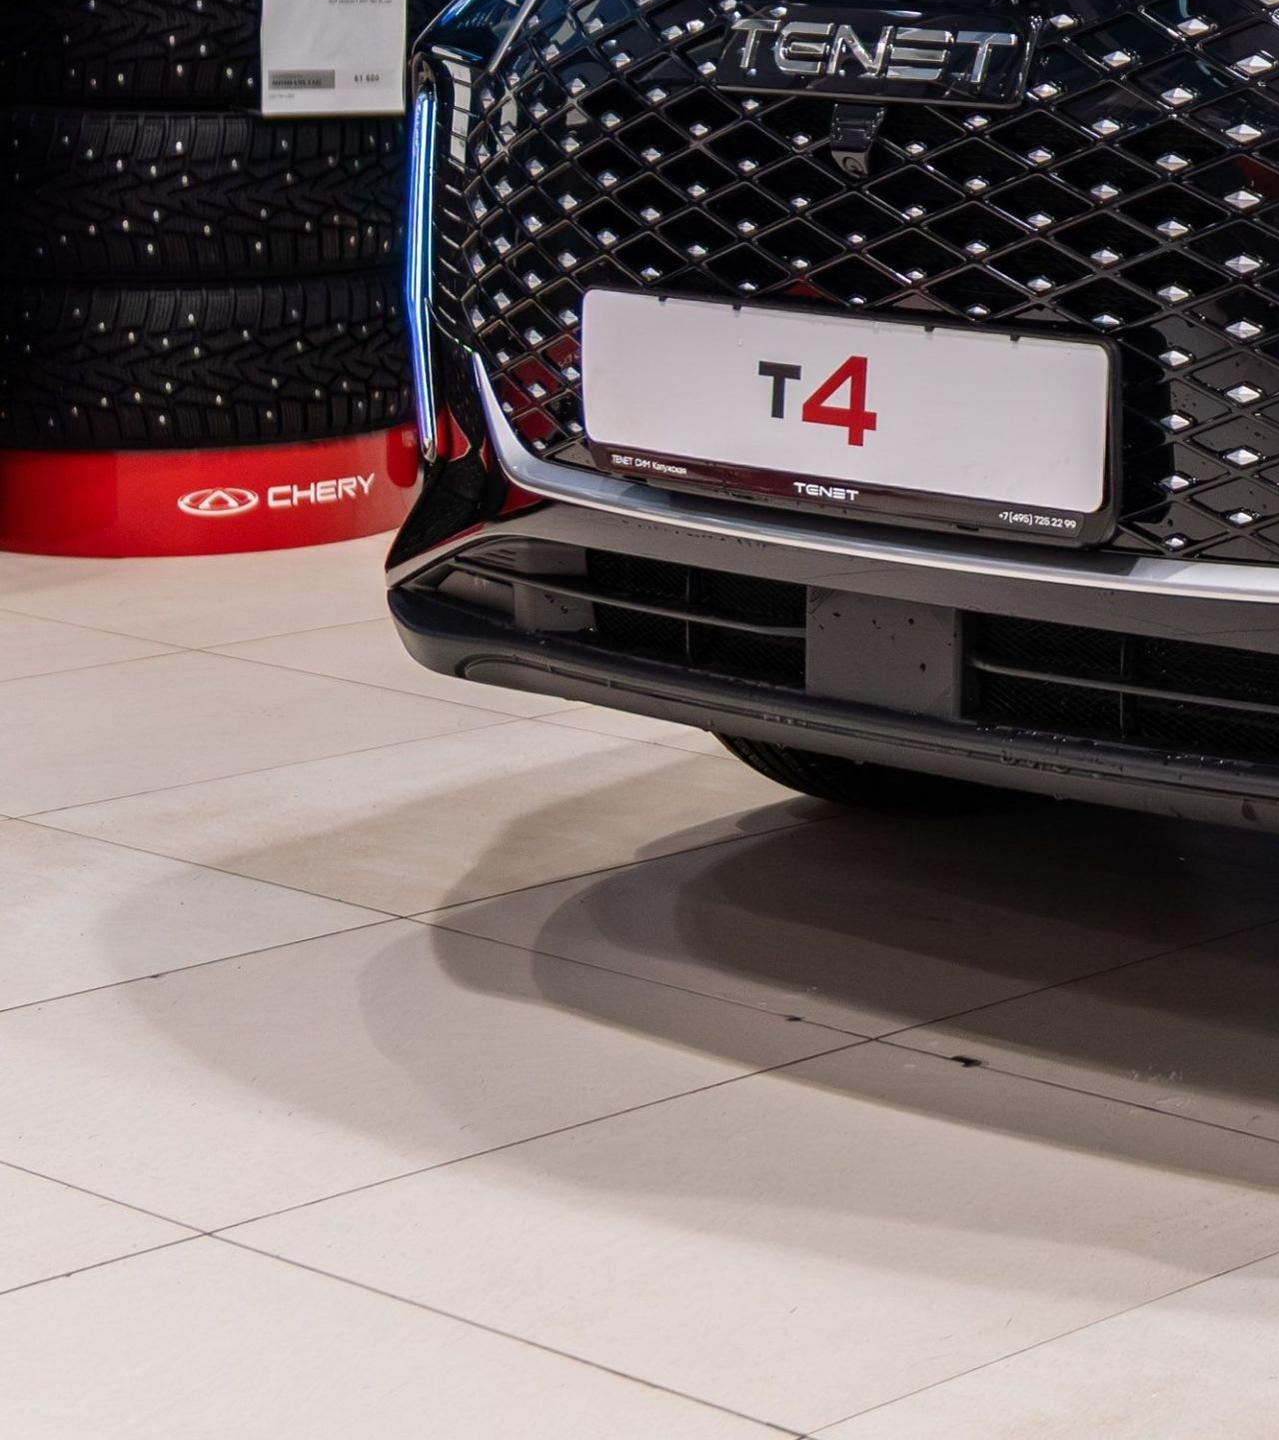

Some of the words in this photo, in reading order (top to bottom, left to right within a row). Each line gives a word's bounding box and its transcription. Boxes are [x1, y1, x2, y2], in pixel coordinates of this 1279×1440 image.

[730, 18, 1019, 84] TENET
[757, 355, 878, 447] T4
[266, 472, 375, 508] CHERY
[793, 480, 860, 501] TENET
[1064, 519, 1077, 529] 99
